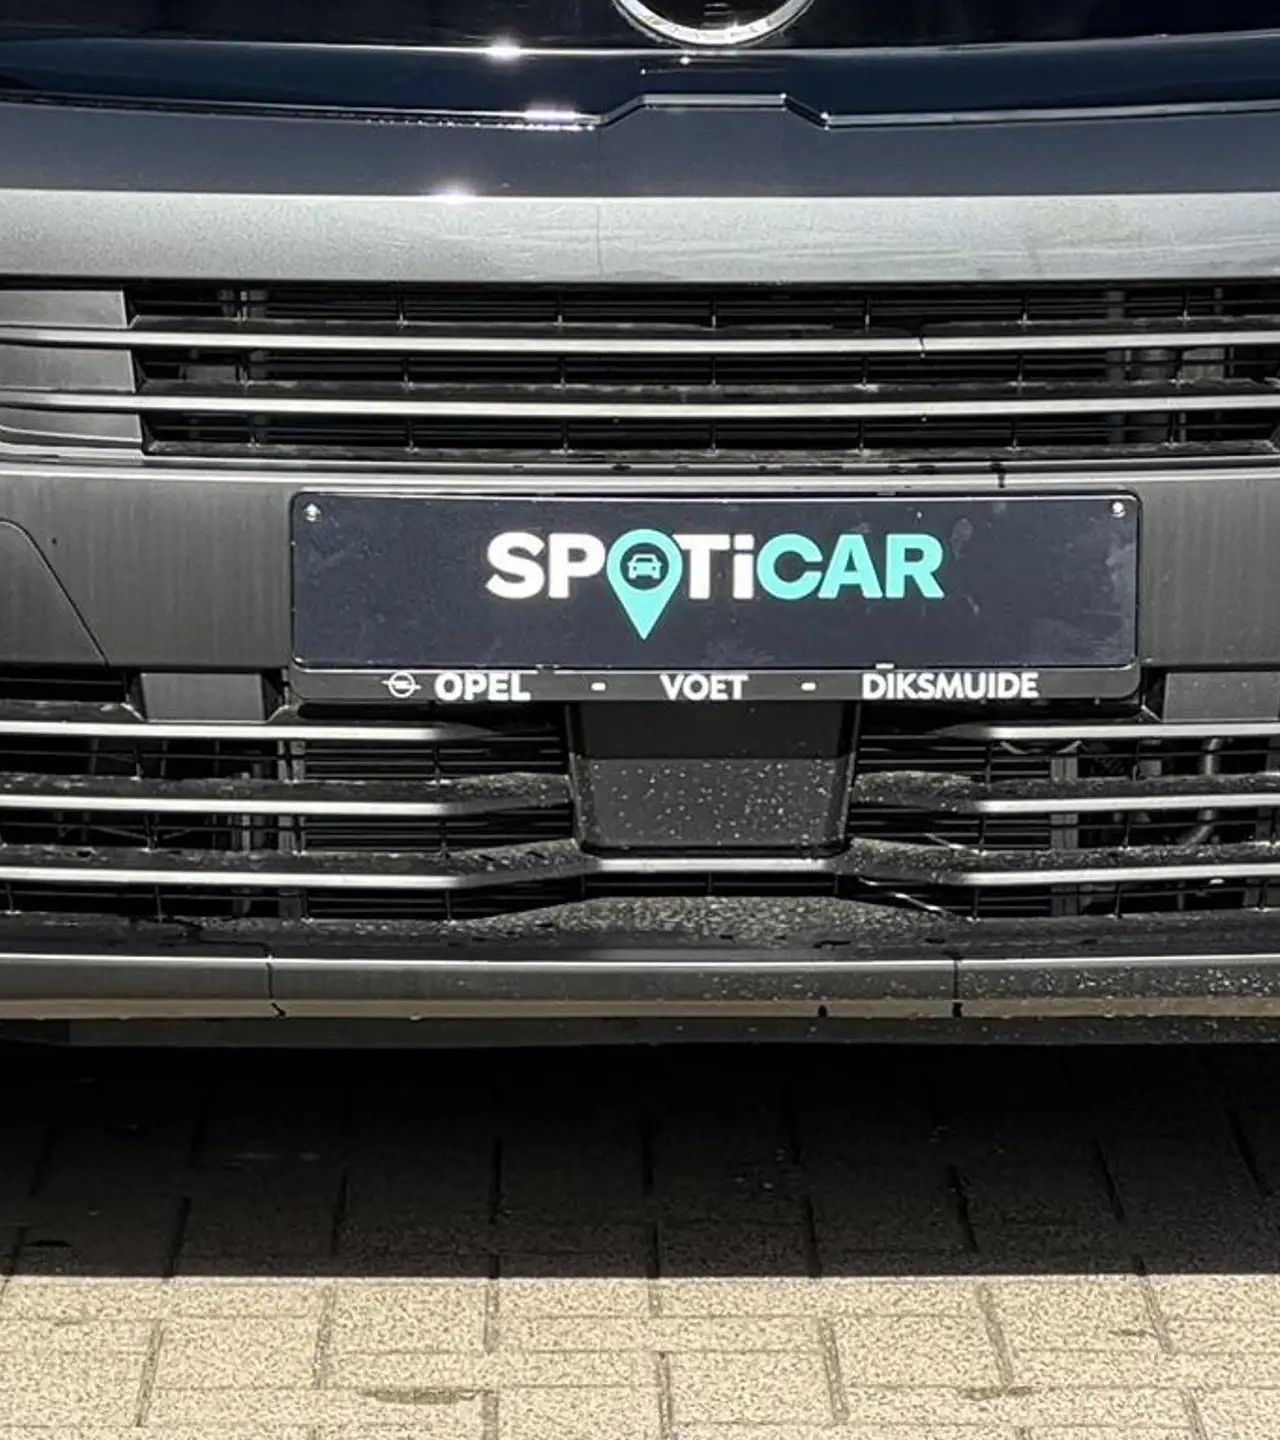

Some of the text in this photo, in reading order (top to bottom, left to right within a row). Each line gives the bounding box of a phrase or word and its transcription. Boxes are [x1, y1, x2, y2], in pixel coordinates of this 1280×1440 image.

[434, 672, 532, 702] OPEL
[660, 673, 750, 701] VOET
[861, 671, 1040, 701] DIKSMUIDE
